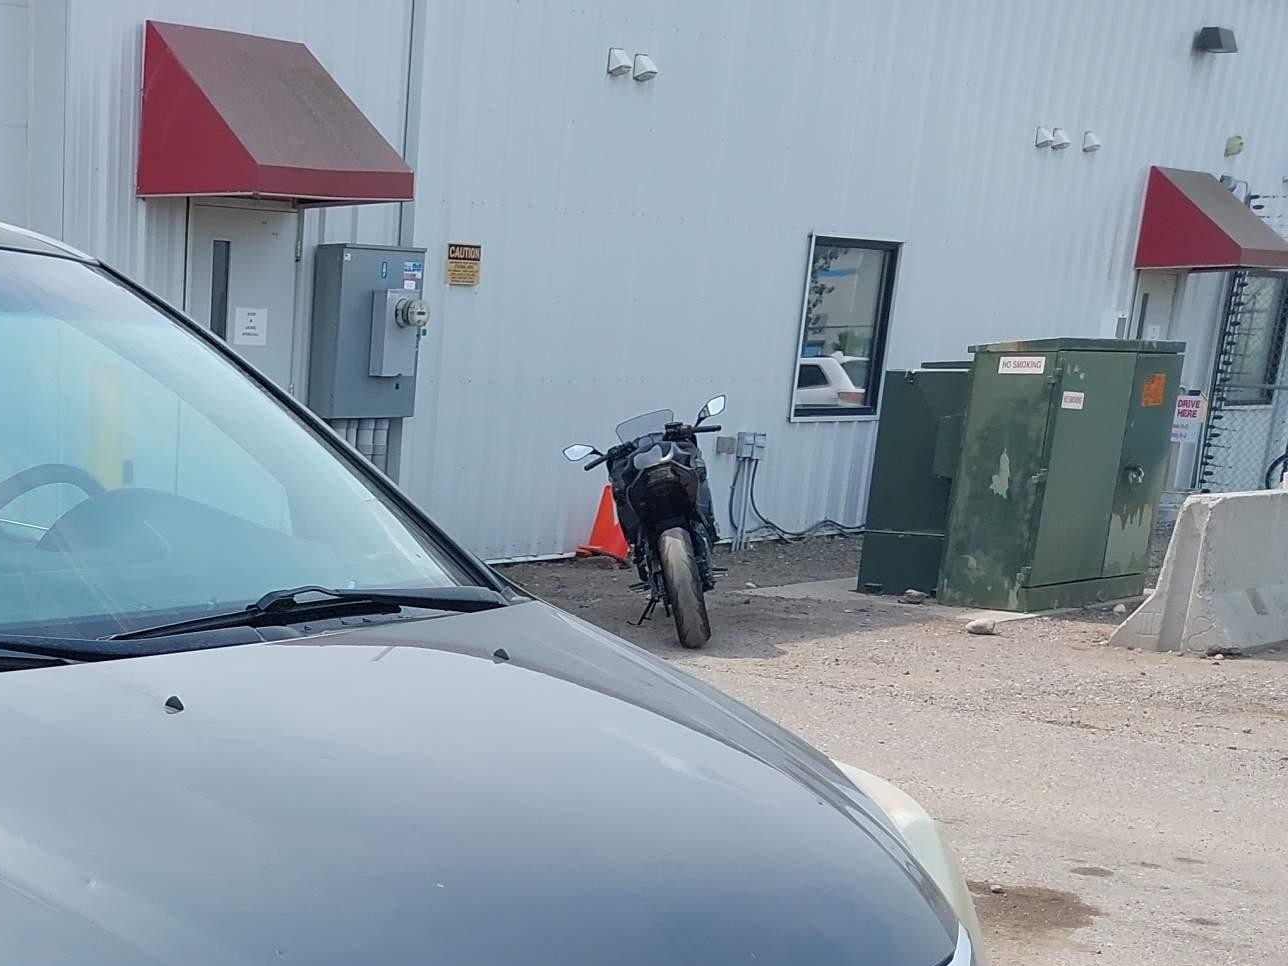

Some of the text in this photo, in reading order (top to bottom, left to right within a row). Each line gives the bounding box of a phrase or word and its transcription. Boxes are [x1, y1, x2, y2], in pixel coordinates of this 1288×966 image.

[449, 246, 480, 259] CAUTION
[1001, 360, 1042, 369] NO SMOKING
[1177, 399, 1201, 409] DRIVE
[1176, 409, 1198, 418] HERE
